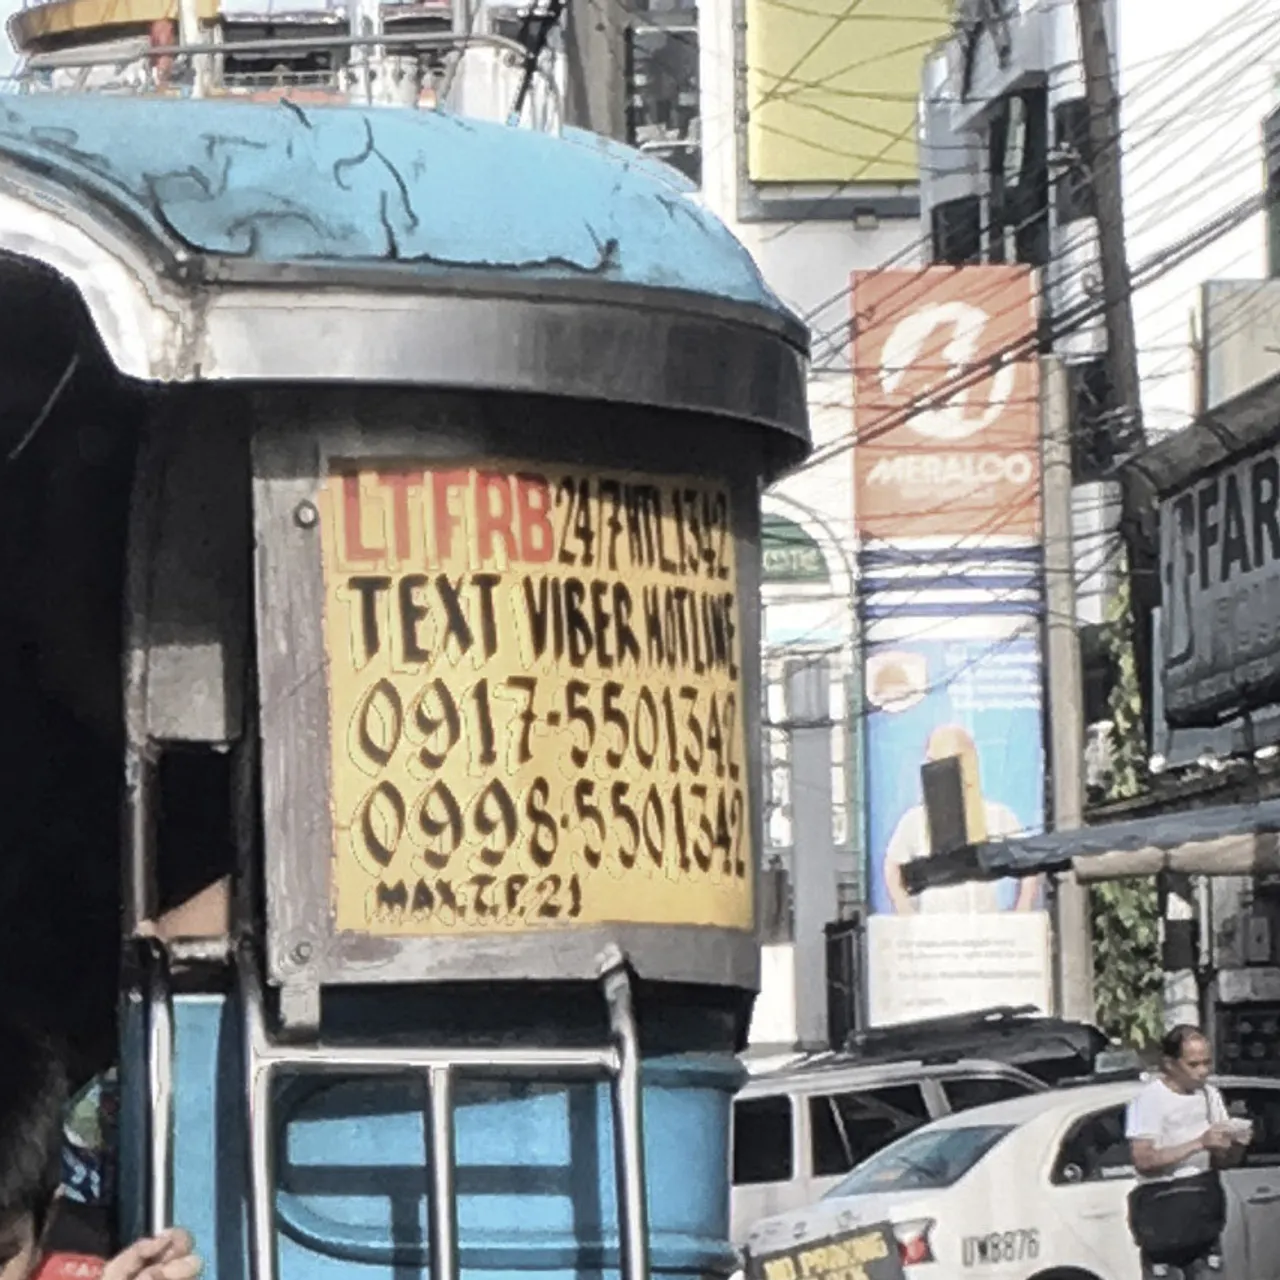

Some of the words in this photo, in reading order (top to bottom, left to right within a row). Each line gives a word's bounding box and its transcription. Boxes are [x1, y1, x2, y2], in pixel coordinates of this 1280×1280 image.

[344, 467, 555, 565] LTFRB
[345, 573, 502, 664] TEXT
[522, 573, 641, 669] VIBER
[642, 583, 738, 681] HOTLINE
[357, 675, 740, 782] 0917-5501342
